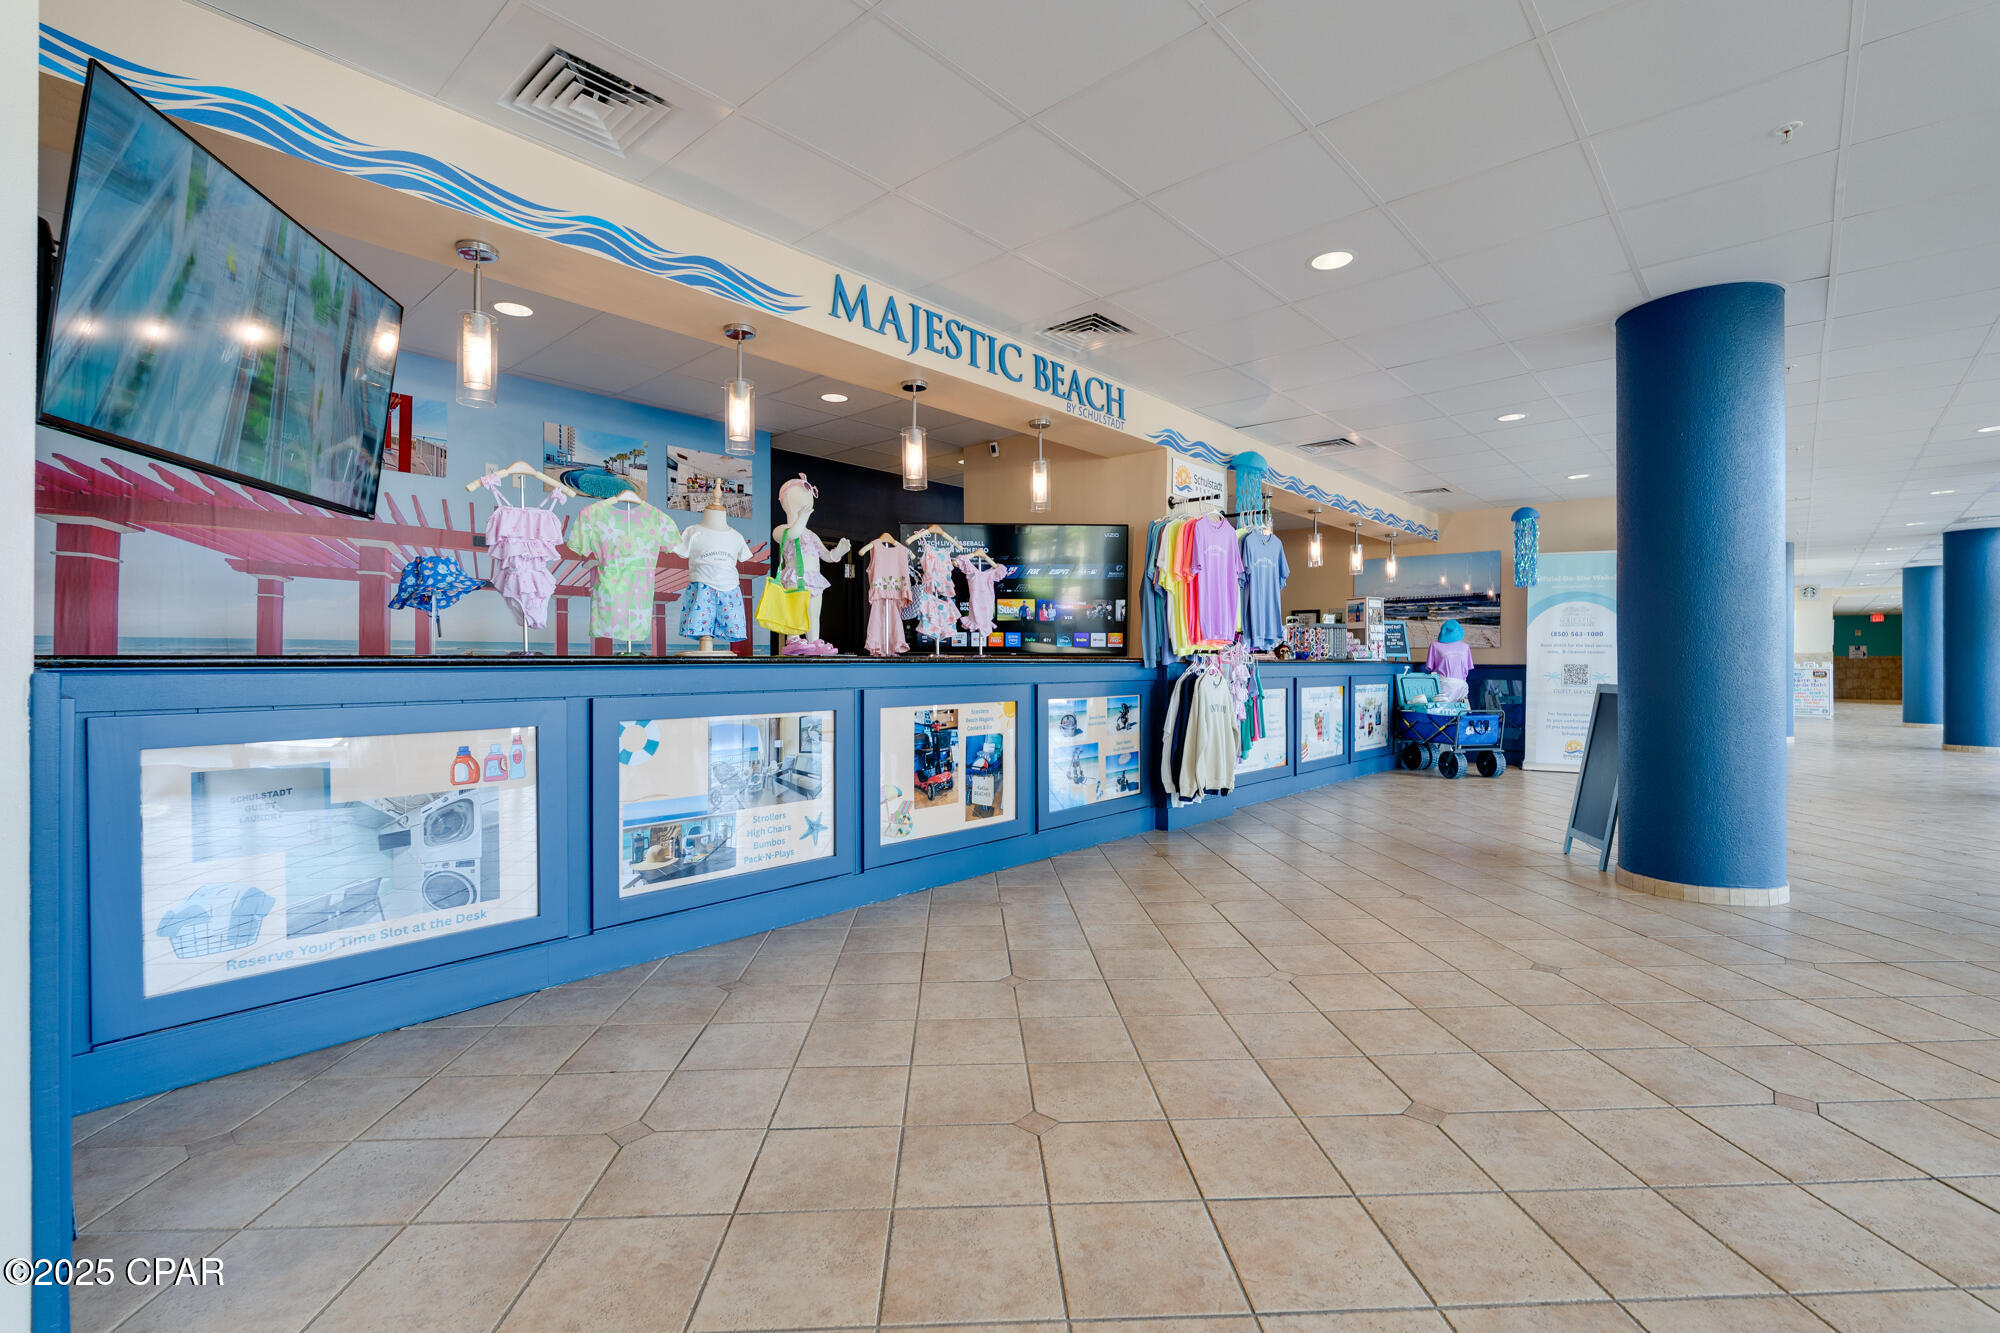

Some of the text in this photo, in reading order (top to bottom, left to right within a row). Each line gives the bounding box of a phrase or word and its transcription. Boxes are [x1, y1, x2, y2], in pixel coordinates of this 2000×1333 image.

[828, 274, 1127, 421] MAJESTIC BEACH
[1066, 402, 1125, 431] BY SCHULSTADT
[1193, 473, 1223, 492] Schulstadt
[231, 787, 293, 804] SCHULSTADT
[752, 812, 787, 824] Strollers
[746, 823, 792, 839] High Chairs
[753, 838, 786, 850] Bumbos
[743, 848, 796, 864] Pack-N-Plays
[226, 909, 488, 972] Reserve Your Time Slot at the Desk
